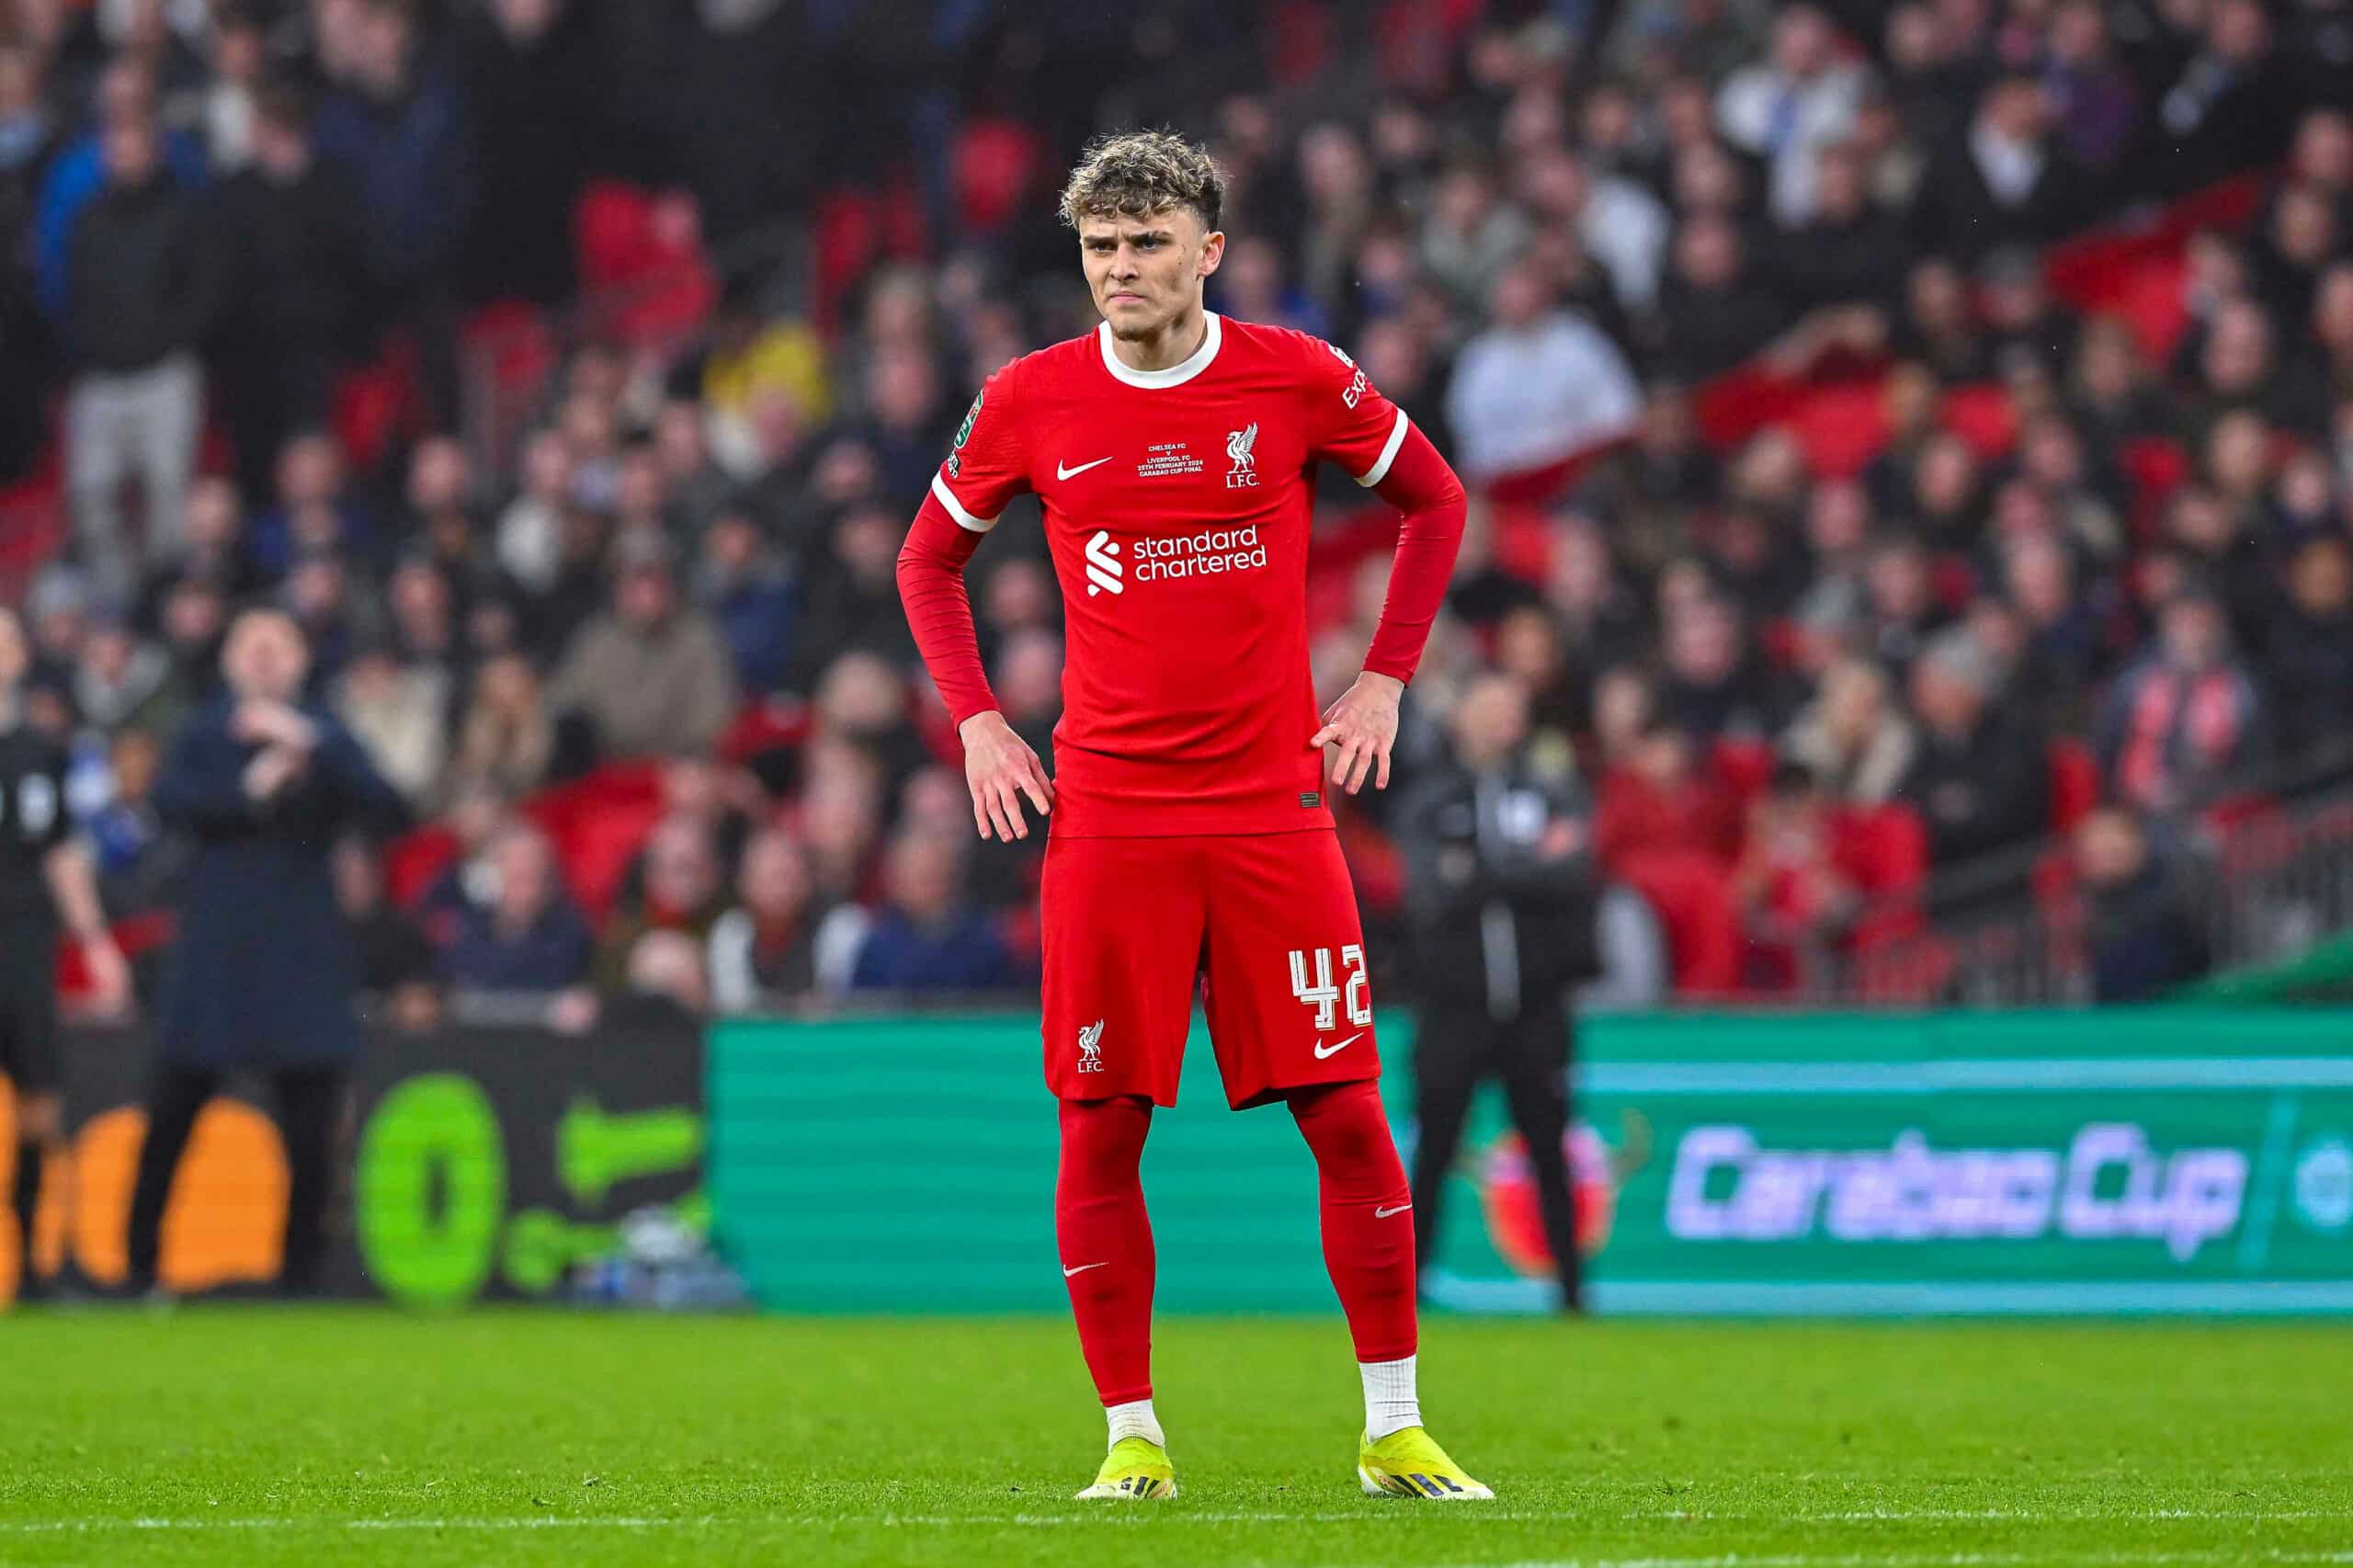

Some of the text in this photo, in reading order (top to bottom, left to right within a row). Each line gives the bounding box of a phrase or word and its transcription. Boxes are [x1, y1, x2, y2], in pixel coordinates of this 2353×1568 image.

[1133, 524, 1257, 560] standard
[1135, 545, 1267, 581] chartered
[1289, 944, 1372, 1031] 42
[2059, 1121, 2248, 1261] Cup
